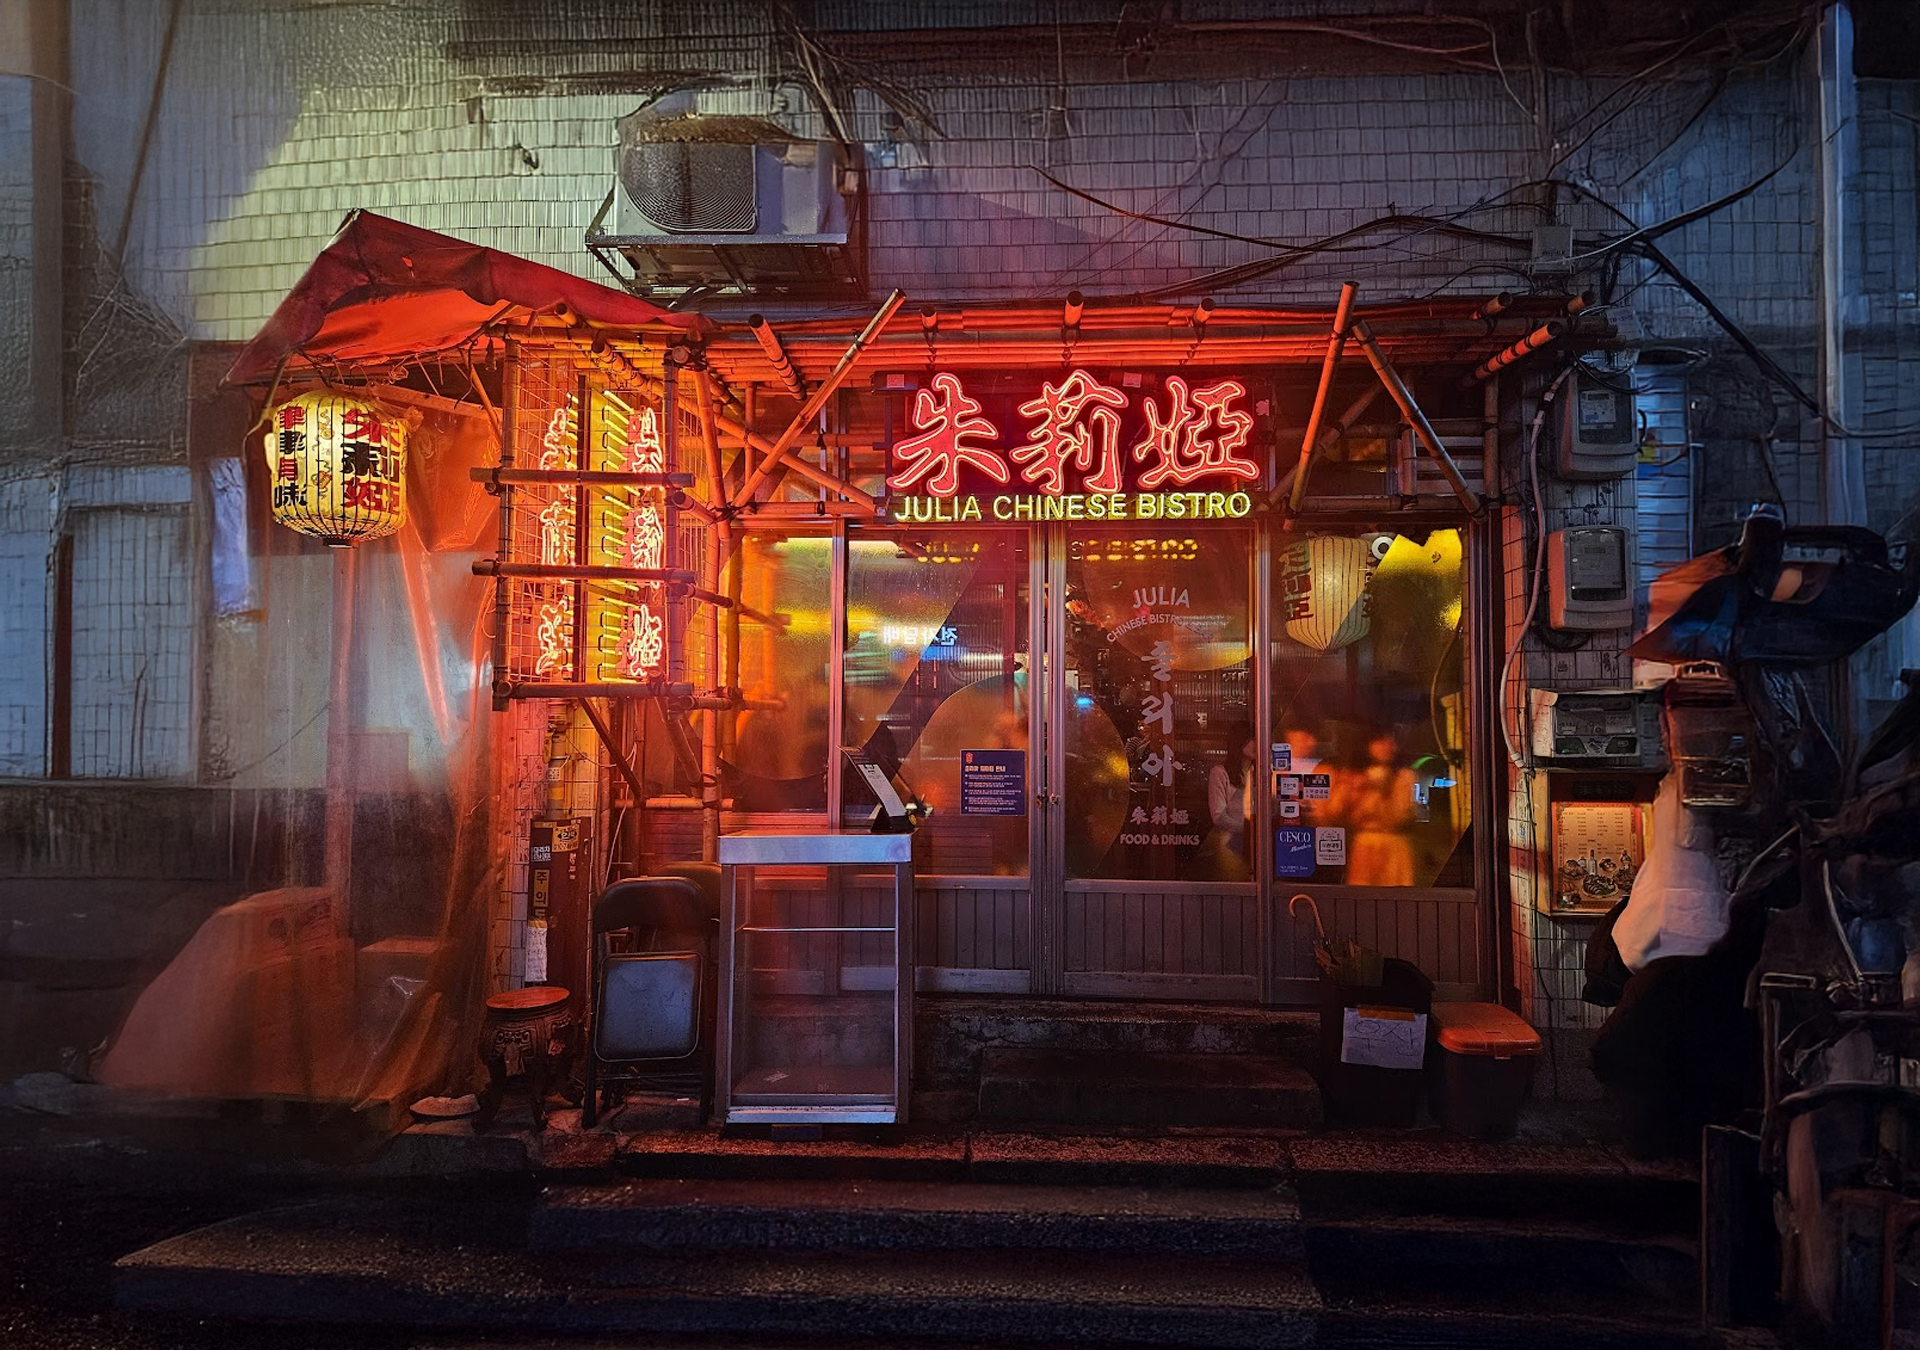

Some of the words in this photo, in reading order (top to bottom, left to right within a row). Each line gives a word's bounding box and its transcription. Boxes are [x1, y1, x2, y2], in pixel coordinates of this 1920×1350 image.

[886, 369, 1261, 495] 朱莉婭
[895, 494, 982, 521] JULIA
[993, 493, 1128, 521] CHINESE
[1139, 493, 1252, 519] BISTRO
[1132, 586, 1190, 609] JULIA
[1106, 615, 1146, 643] CHINESE
[1141, 640, 1183, 787] 줄리아
[1130, 805, 1190, 826] 朱莉婭
[1120, 833, 1150, 846] FOOD
[1151, 834, 1161, 846] &
[1161, 833, 1200, 846] DRINKS
[1279, 831, 1311, 843] CESCO
[536, 872, 547, 905] 주의
[1348, 1020, 1421, 1057] 우산
